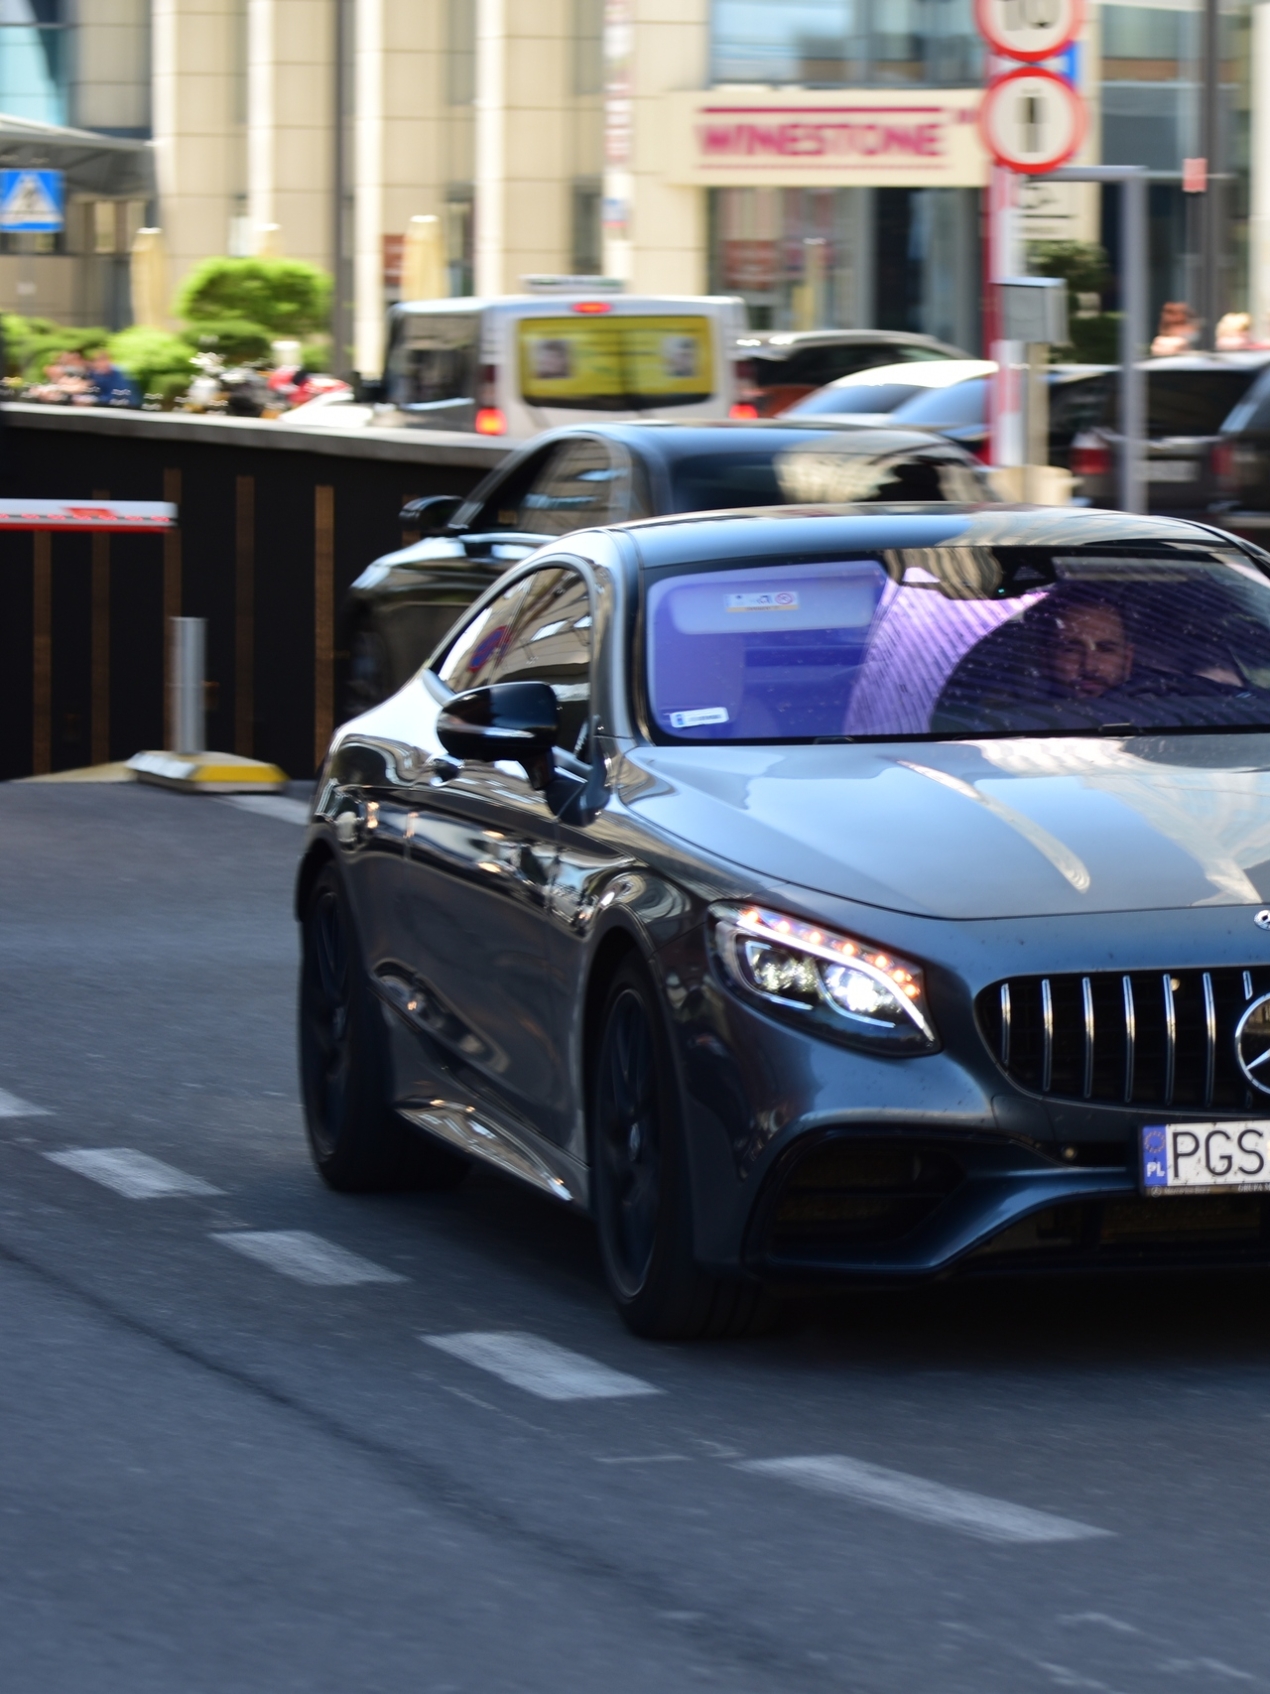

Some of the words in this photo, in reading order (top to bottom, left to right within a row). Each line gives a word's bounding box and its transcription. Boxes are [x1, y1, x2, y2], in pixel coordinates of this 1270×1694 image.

[695, 122, 946, 156] WINESTONE
[1146, 1161, 1166, 1178] PL
[1172, 1128, 1265, 1178] PGS
